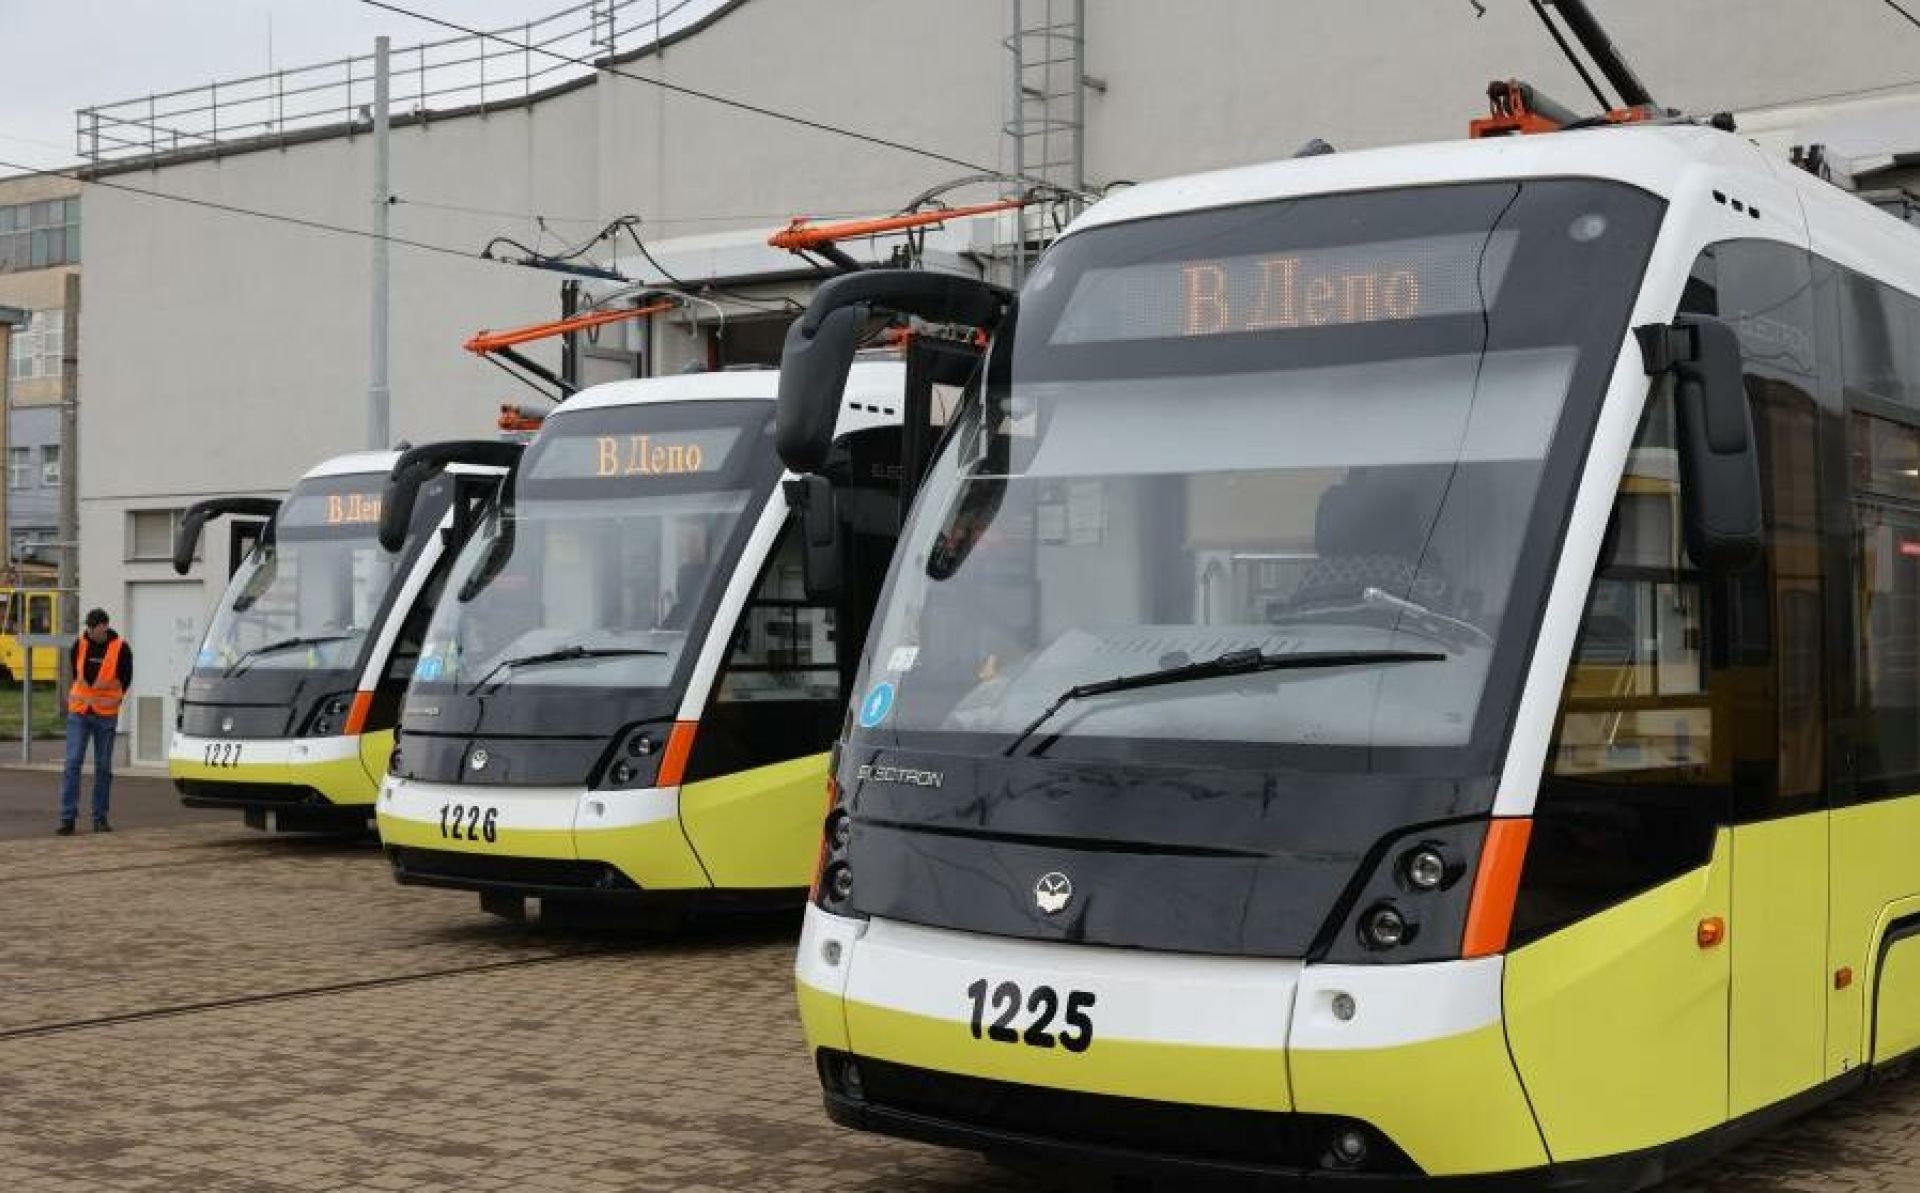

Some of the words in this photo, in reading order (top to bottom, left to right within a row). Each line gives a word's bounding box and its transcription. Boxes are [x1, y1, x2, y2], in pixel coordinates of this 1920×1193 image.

[1182, 262, 1228, 337] В
[1246, 258, 1420, 332] Депо
[596, 436, 618, 476] В
[624, 433, 703, 476] Депо
[326, 494, 343, 523] В
[344, 493, 382, 522] Деп
[204, 743, 242, 768] 1227
[856, 764, 944, 788] ELECTRON
[440, 803, 498, 843] 1226
[967, 978, 1096, 1053] 1225
